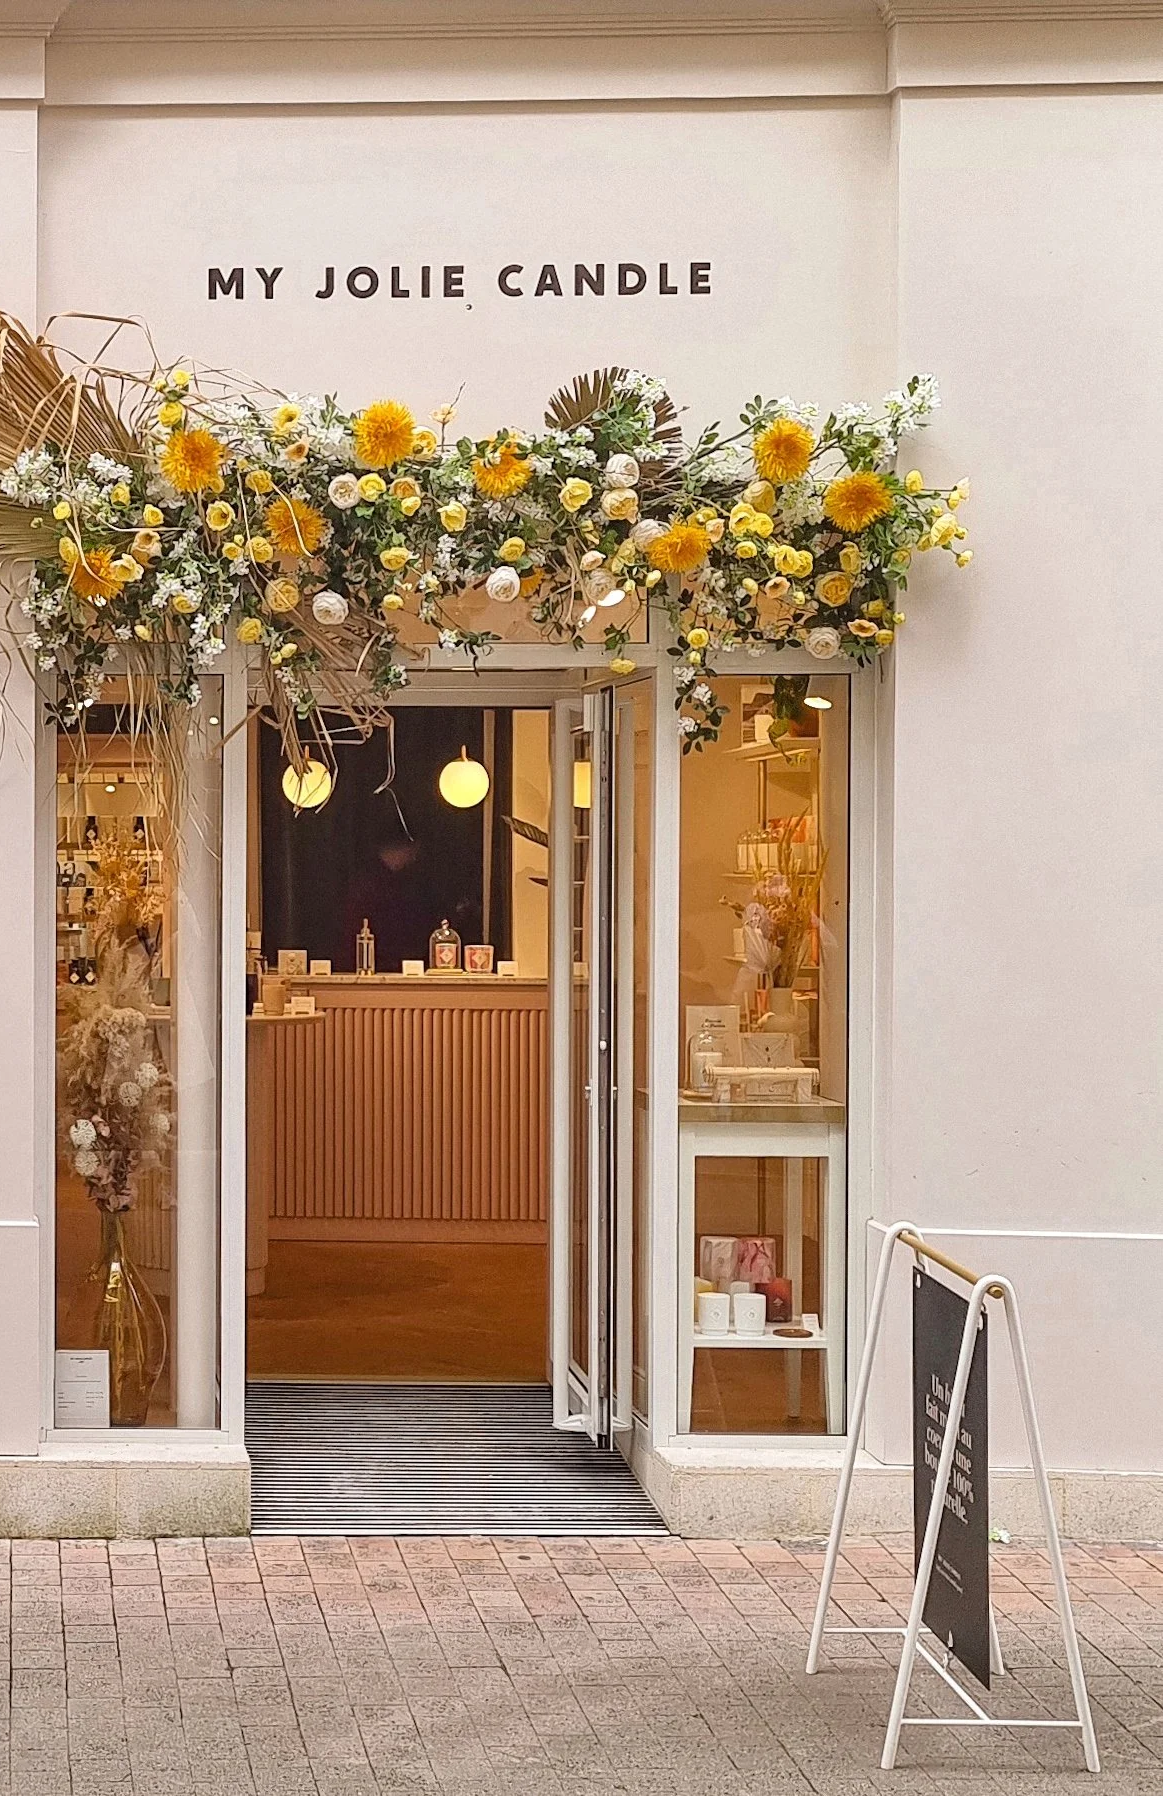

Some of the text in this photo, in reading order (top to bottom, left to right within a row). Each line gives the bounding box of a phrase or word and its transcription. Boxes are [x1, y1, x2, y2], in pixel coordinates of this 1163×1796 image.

[207, 262, 712, 300] MY JOLIE CANDLE
[931, 1373, 944, 1402] Un
[926, 1393, 940, 1424] fait
[960, 1427, 973, 1451] au
[953, 1467, 975, 1504] 100%
